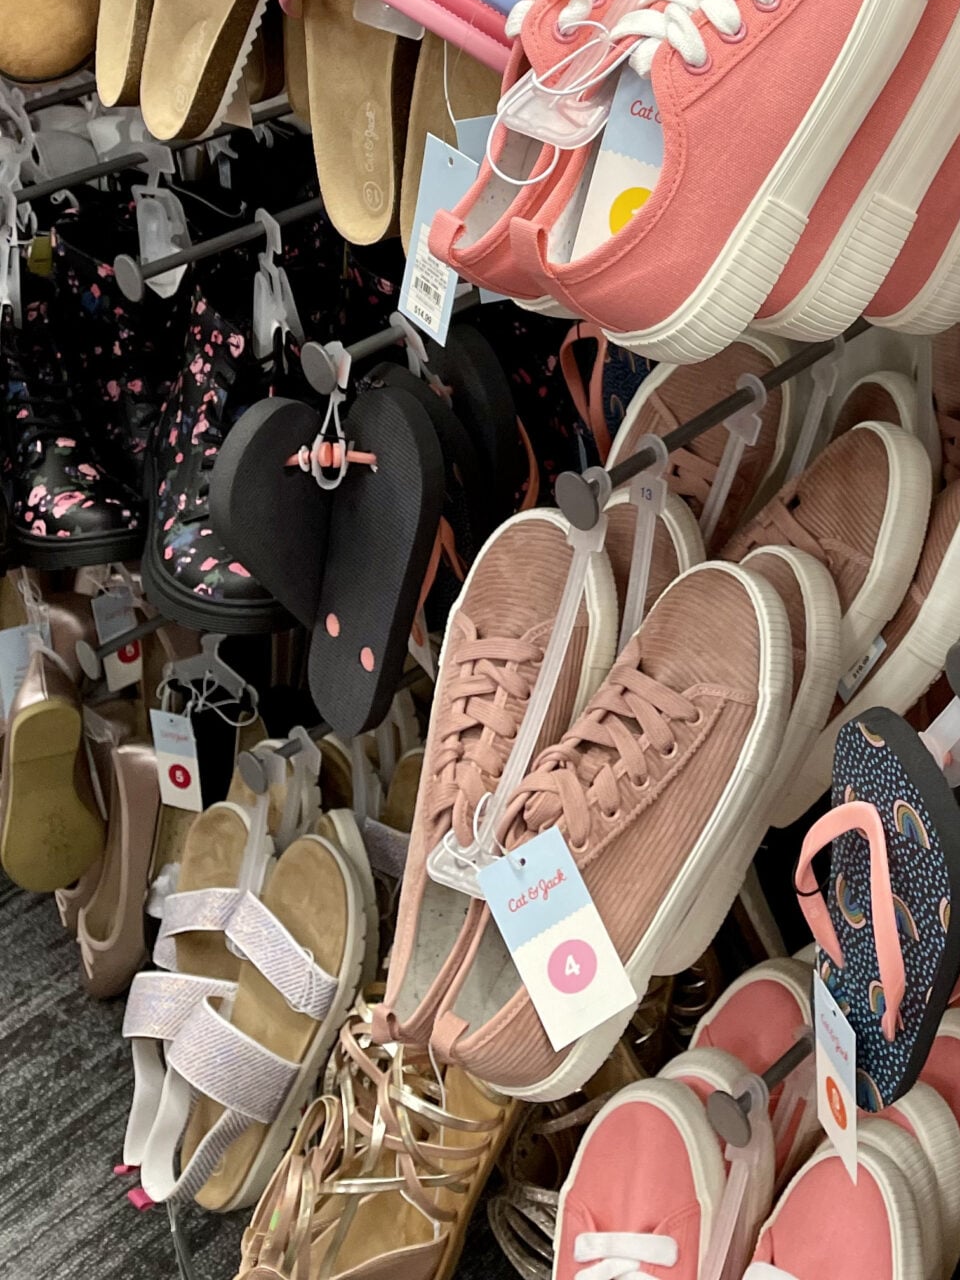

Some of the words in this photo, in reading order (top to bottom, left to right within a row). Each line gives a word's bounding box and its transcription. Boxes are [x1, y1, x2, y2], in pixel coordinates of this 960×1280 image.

[630, 99, 654, 121] Cat
[641, 487, 653, 501] 13
[508, 892, 529, 913] Cat
[528, 886, 539, 901] &
[538, 868, 567, 901] Jack
[564, 953, 581, 977] 4
